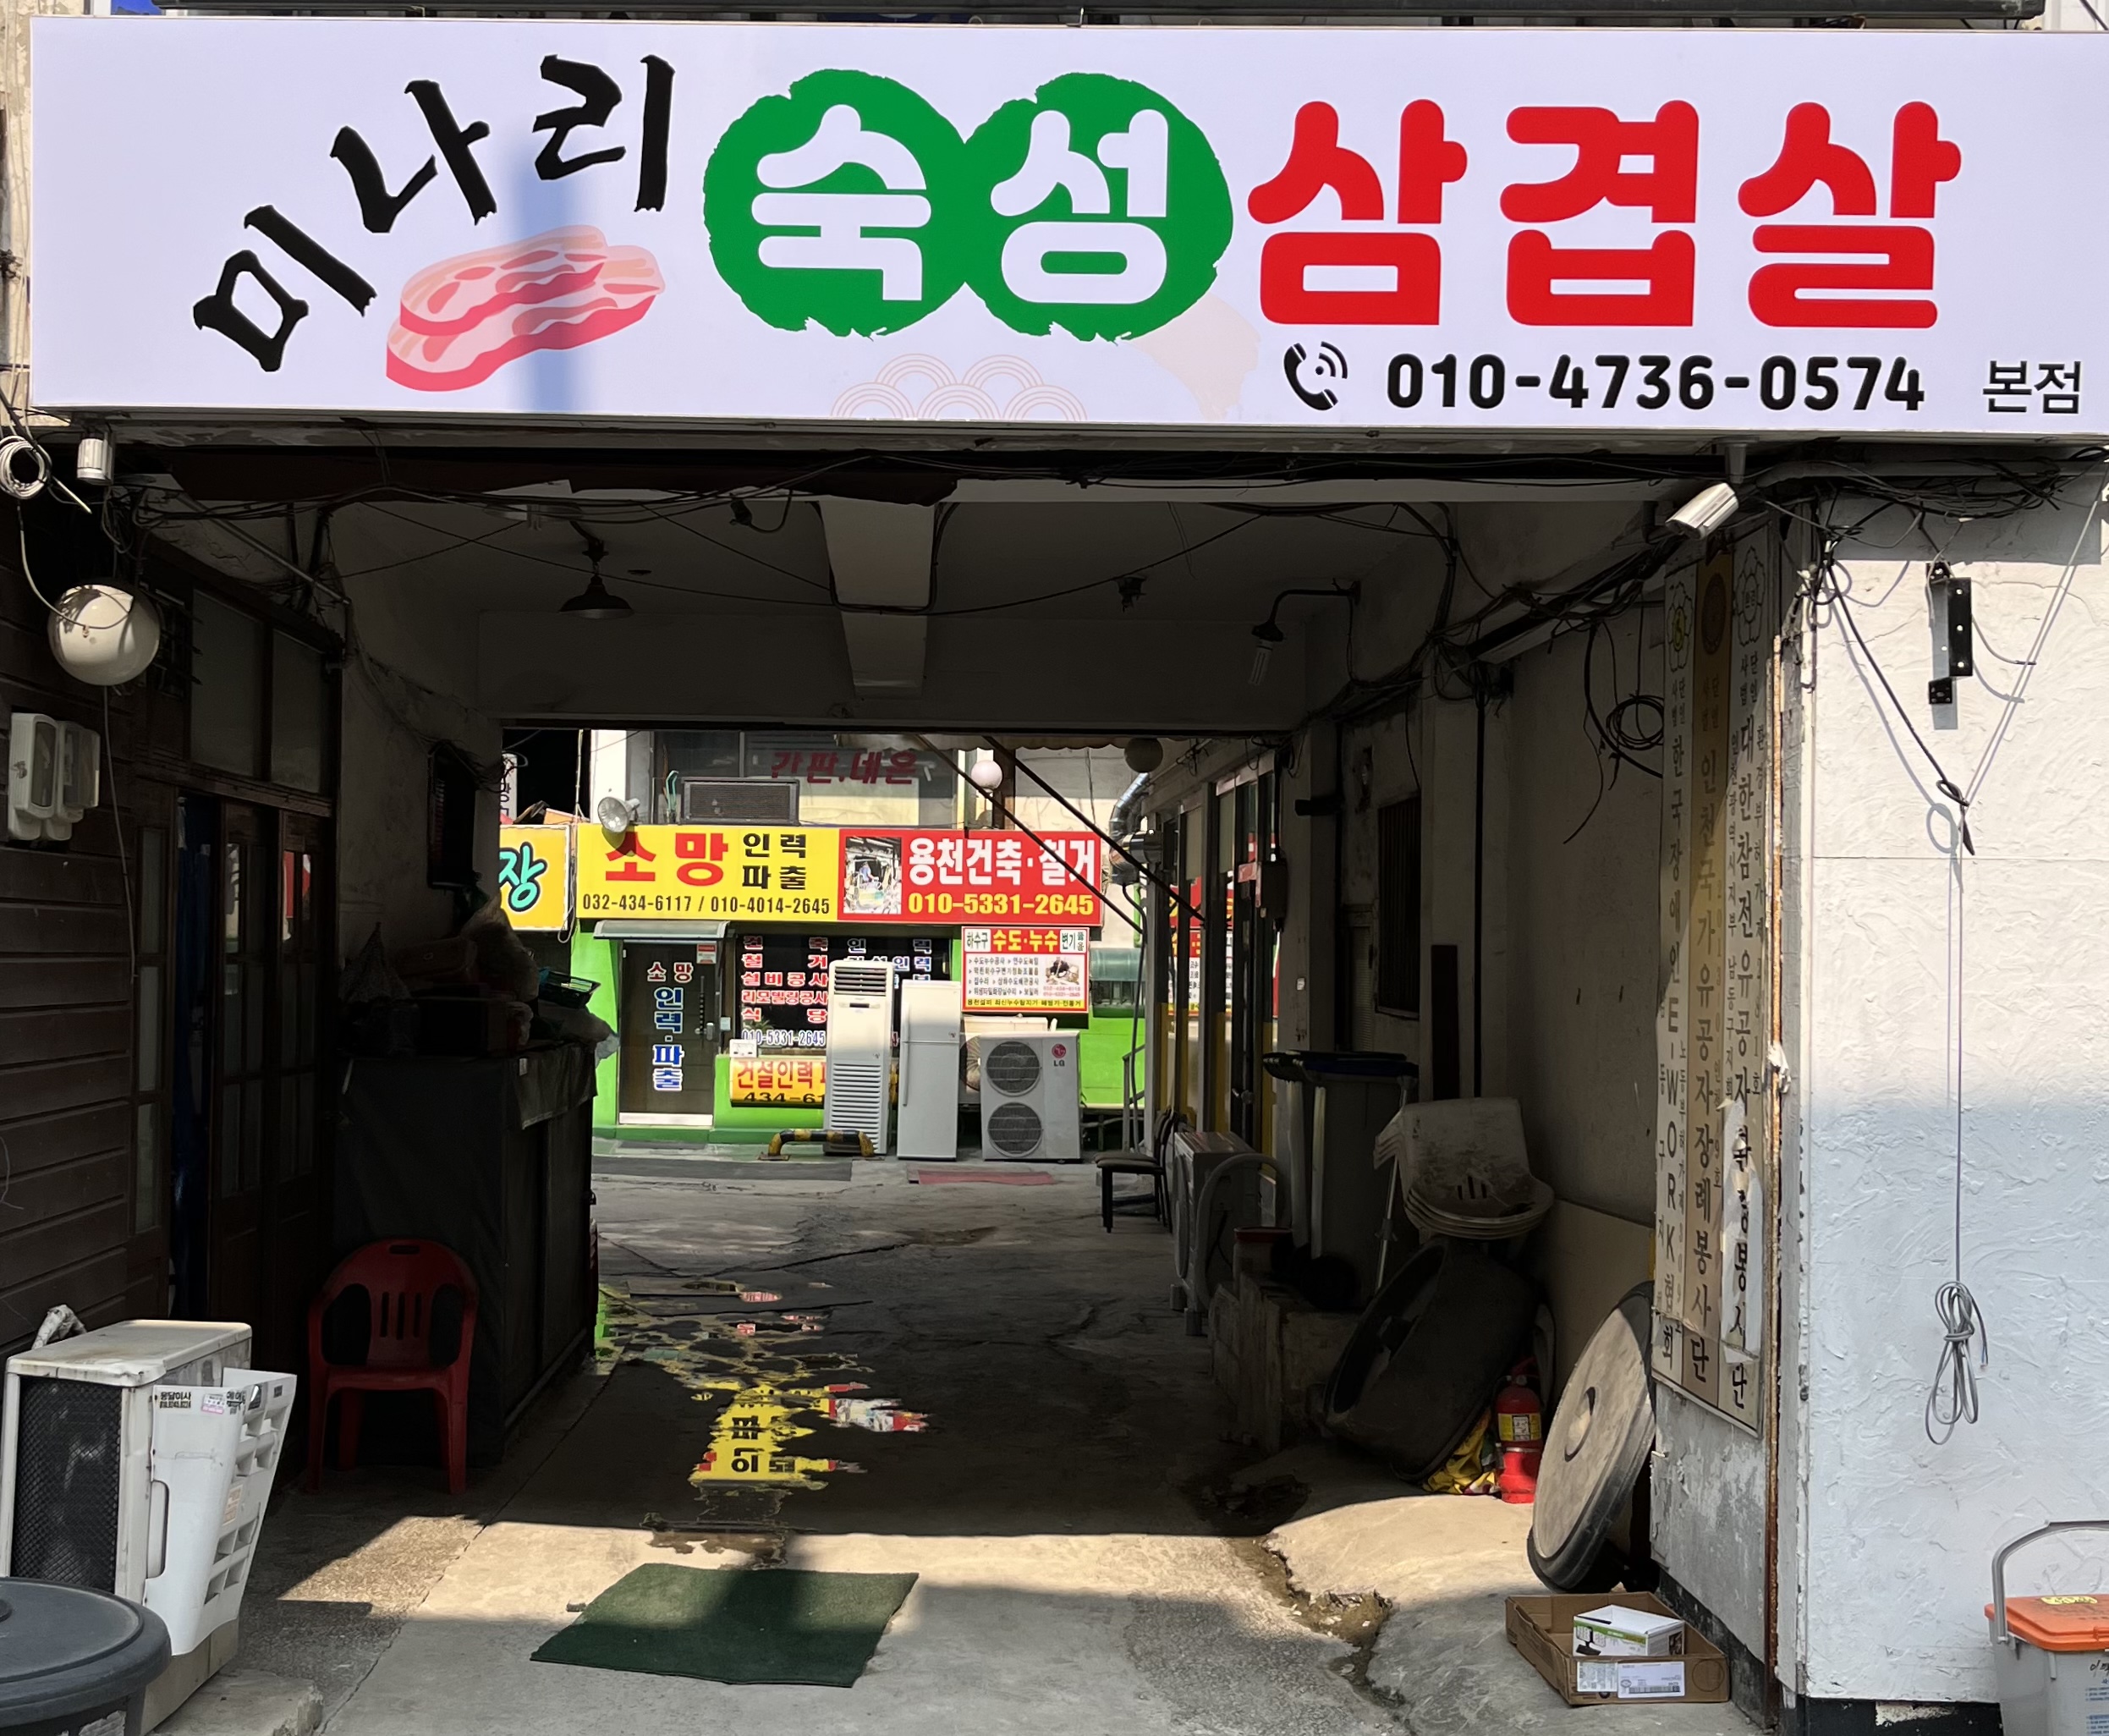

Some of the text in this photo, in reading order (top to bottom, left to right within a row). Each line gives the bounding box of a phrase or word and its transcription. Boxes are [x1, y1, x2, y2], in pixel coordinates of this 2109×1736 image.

[193, 55, 1962, 372] 미나리 숙성 삼겹살
[1388, 354, 2083, 415] 010-4736-0574 본점
[743, 833, 807, 858] 인력
[605, 831, 729, 887] 소망
[742, 865, 807, 891] 파출
[582, 894, 692, 912] 032-434-6117
[711, 896, 831, 915] 010-4014-2645
[908, 893, 1094, 915] 010-5331-2645
[966, 931, 989, 950] 하수구
[992, 929, 1058, 953] 수도·누수
[646, 962, 694, 983] 소망
[741, 972, 828, 987] 설비공사
[741, 1008, 828, 1024] 식당
[741, 1029, 827, 1047] 010-5331-2645
[737, 1061, 813, 1090] 건설인력
